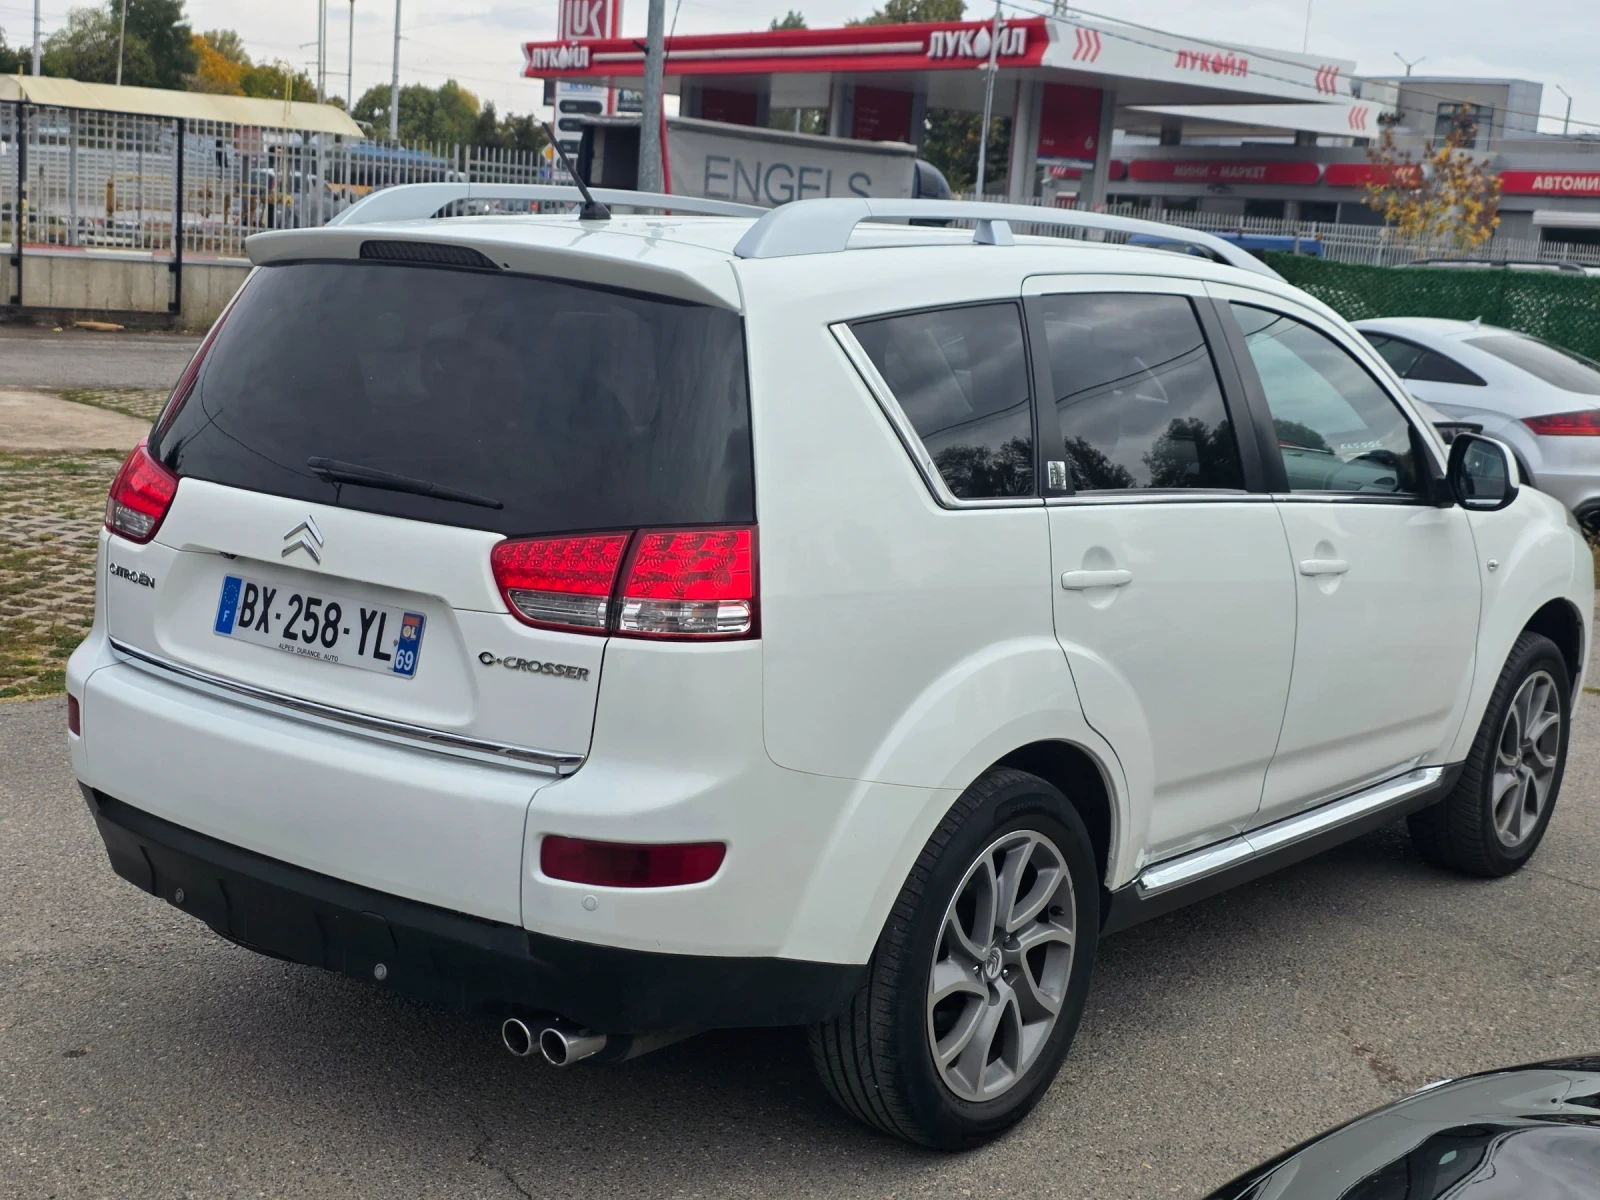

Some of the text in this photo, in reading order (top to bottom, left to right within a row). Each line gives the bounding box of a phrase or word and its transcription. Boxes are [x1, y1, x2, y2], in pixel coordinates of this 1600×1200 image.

[1532, 175, 1600, 191] АВТОМИ
[222, 610, 230, 622] F
[278, 643, 339, 663] ALPES DURANCE AUTO
[395, 649, 414, 671] 69
